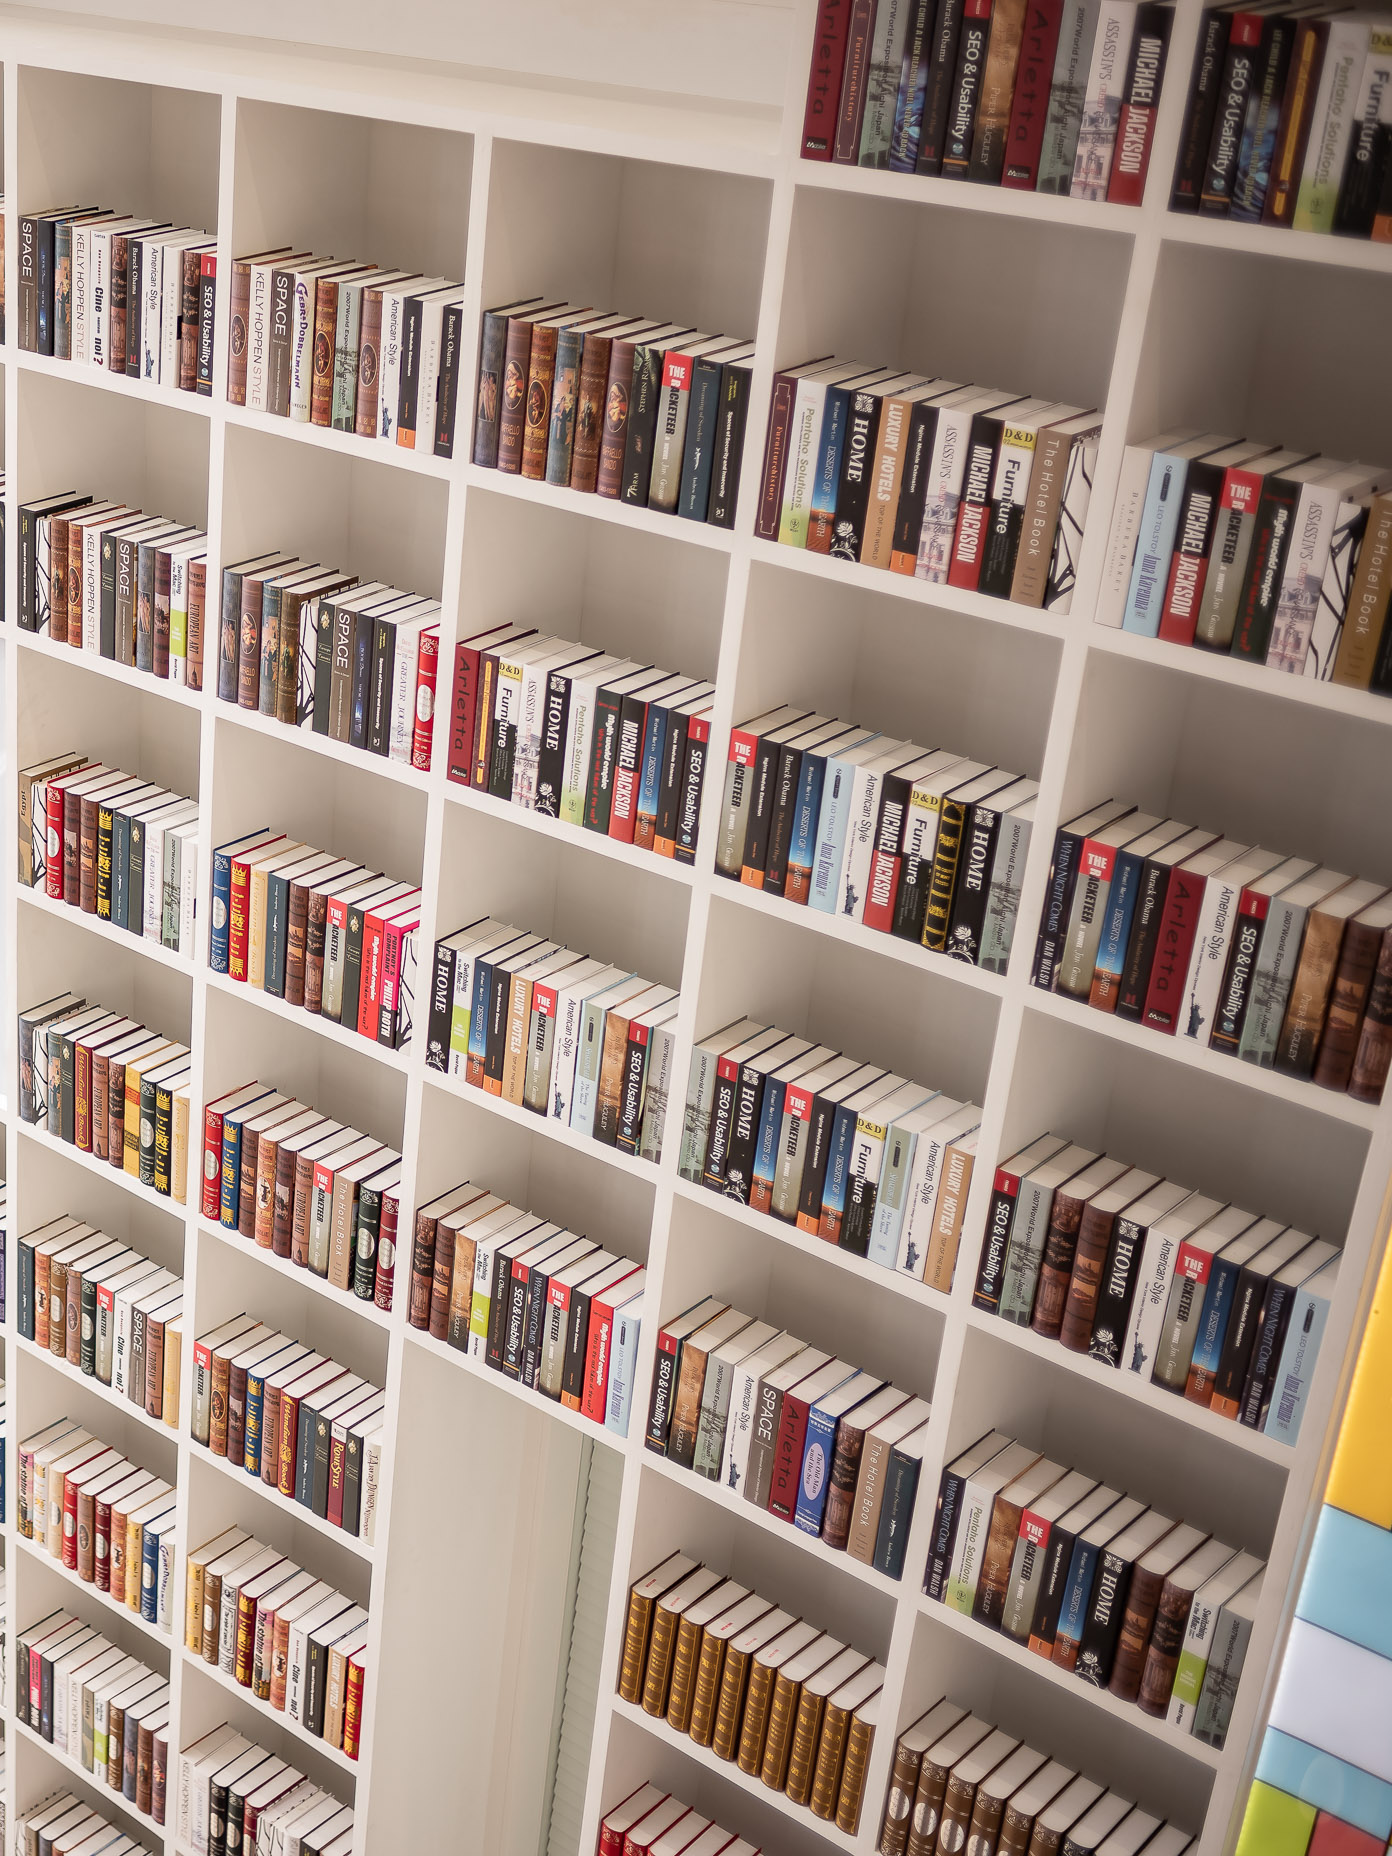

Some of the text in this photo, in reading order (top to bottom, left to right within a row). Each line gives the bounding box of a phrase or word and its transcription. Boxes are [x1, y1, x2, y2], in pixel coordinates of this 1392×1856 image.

[939, 31, 950, 62] Obama
[1015, 9, 1049, 141] Arletta
[1199, 55, 1213, 92] Obama
[952, 30, 982, 139] SEO & Usability
[1119, 38, 1162, 174] MICHAEL JACKSON
[1212, 57, 1249, 176] SEO & Usability
[1357, 69, 1390, 162] Furniture
[1318, 122, 1341, 185] Solutions
[22, 222, 32, 278] SPACE
[76, 234, 84, 359] KELLY HOPPEN STYLE
[95, 287, 104, 312] Cine
[199, 286, 213, 367] SEO & Usability
[275, 276, 288, 336] SPACE
[251, 272, 265, 405] KELLY HOPPEN STYLE
[668, 364, 685, 380] THE
[665, 380, 680, 435] RACKETEER
[1005, 428, 1033, 442] D & D
[795, 407, 815, 510] Pentaho Solutions
[847, 419, 869, 482] HOME
[877, 403, 904, 502] LUXURY HOTELS
[956, 445, 993, 563] MICHAEL JACKSON
[996, 458, 1021, 534] Furniture
[1027, 440, 1060, 556] The Hotel Book
[1230, 483, 1252, 500] THE
[1170, 493, 1212, 617] MICHAEL JACKSON
[1222, 501, 1244, 565] RACKETEER
[87, 566, 95, 616] HOPPEN
[119, 543, 130, 596] SPACE
[1356, 545, 1387, 634] Hotel Book
[87, 617, 95, 650] STYLE
[189, 636, 199, 654] ART
[336, 612, 350, 669] SPACE
[454, 656, 471, 750] Arletta
[497, 688, 512, 748] Furniture
[546, 695, 563, 751] HOME
[572, 705, 587, 792] Pentaho Solutions
[614, 719, 639, 819] MICHAEL JACKSON
[734, 742, 751, 756] THE
[680, 749, 703, 833] SEO & Usability
[733, 756, 746, 808] RACKETEER
[781, 754, 794, 806] Barack Obama
[858, 774, 879, 843] American Style
[870, 800, 903, 907] MICHAEL JACKSON
[906, 818, 928, 885] Furniture
[967, 830, 989, 891] HOME
[1087, 853, 1107, 869] THE
[330, 907, 343, 919] THE
[1080, 868, 1102, 925] RACKETEER
[1141, 868, 1160, 925] Barack Obama
[1207, 886, 1235, 960] American Style
[1038, 940, 1057, 986] DAN WALSH
[1156, 881, 1192, 991] Arletta
[434, 963, 449, 1014] HOME
[1221, 926, 1257, 1022] SEO & Usability
[381, 979, 393, 1038] PHILIP ROTH
[508, 979, 526, 1055] LUXURY HOTELS
[708, 1086, 732, 1165] SEO & Usability
[737, 1087, 755, 1140] HOME
[790, 1095, 806, 1110] THE
[852, 1143, 872, 1204] Furniture
[920, 1141, 938, 1205] American Style
[939, 1153, 966, 1236] LUXURY HOTELS
[980, 1201, 1011, 1285] SEO Usability
[1108, 1239, 1134, 1299] HOME
[1150, 1238, 1174, 1306] American Style
[1183, 1256, 1204, 1272] THE
[507, 1286, 524, 1354] SEO Usability
[551, 1287, 565, 1302] THE
[1176, 1270, 1197, 1324] RACKETEER
[758, 1387, 777, 1441] SPACE
[1244, 1381, 1263, 1425] DAN WALSH
[776, 1404, 801, 1489] Arletta
[860, 1444, 882, 1526] The Hotel Book
[961, 1506, 983, 1585] Pentaho Solutions
[1025, 1521, 1044, 1539] THE
[1093, 1571, 1118, 1626] HOME
[1196, 1608, 1211, 1640] Switching
